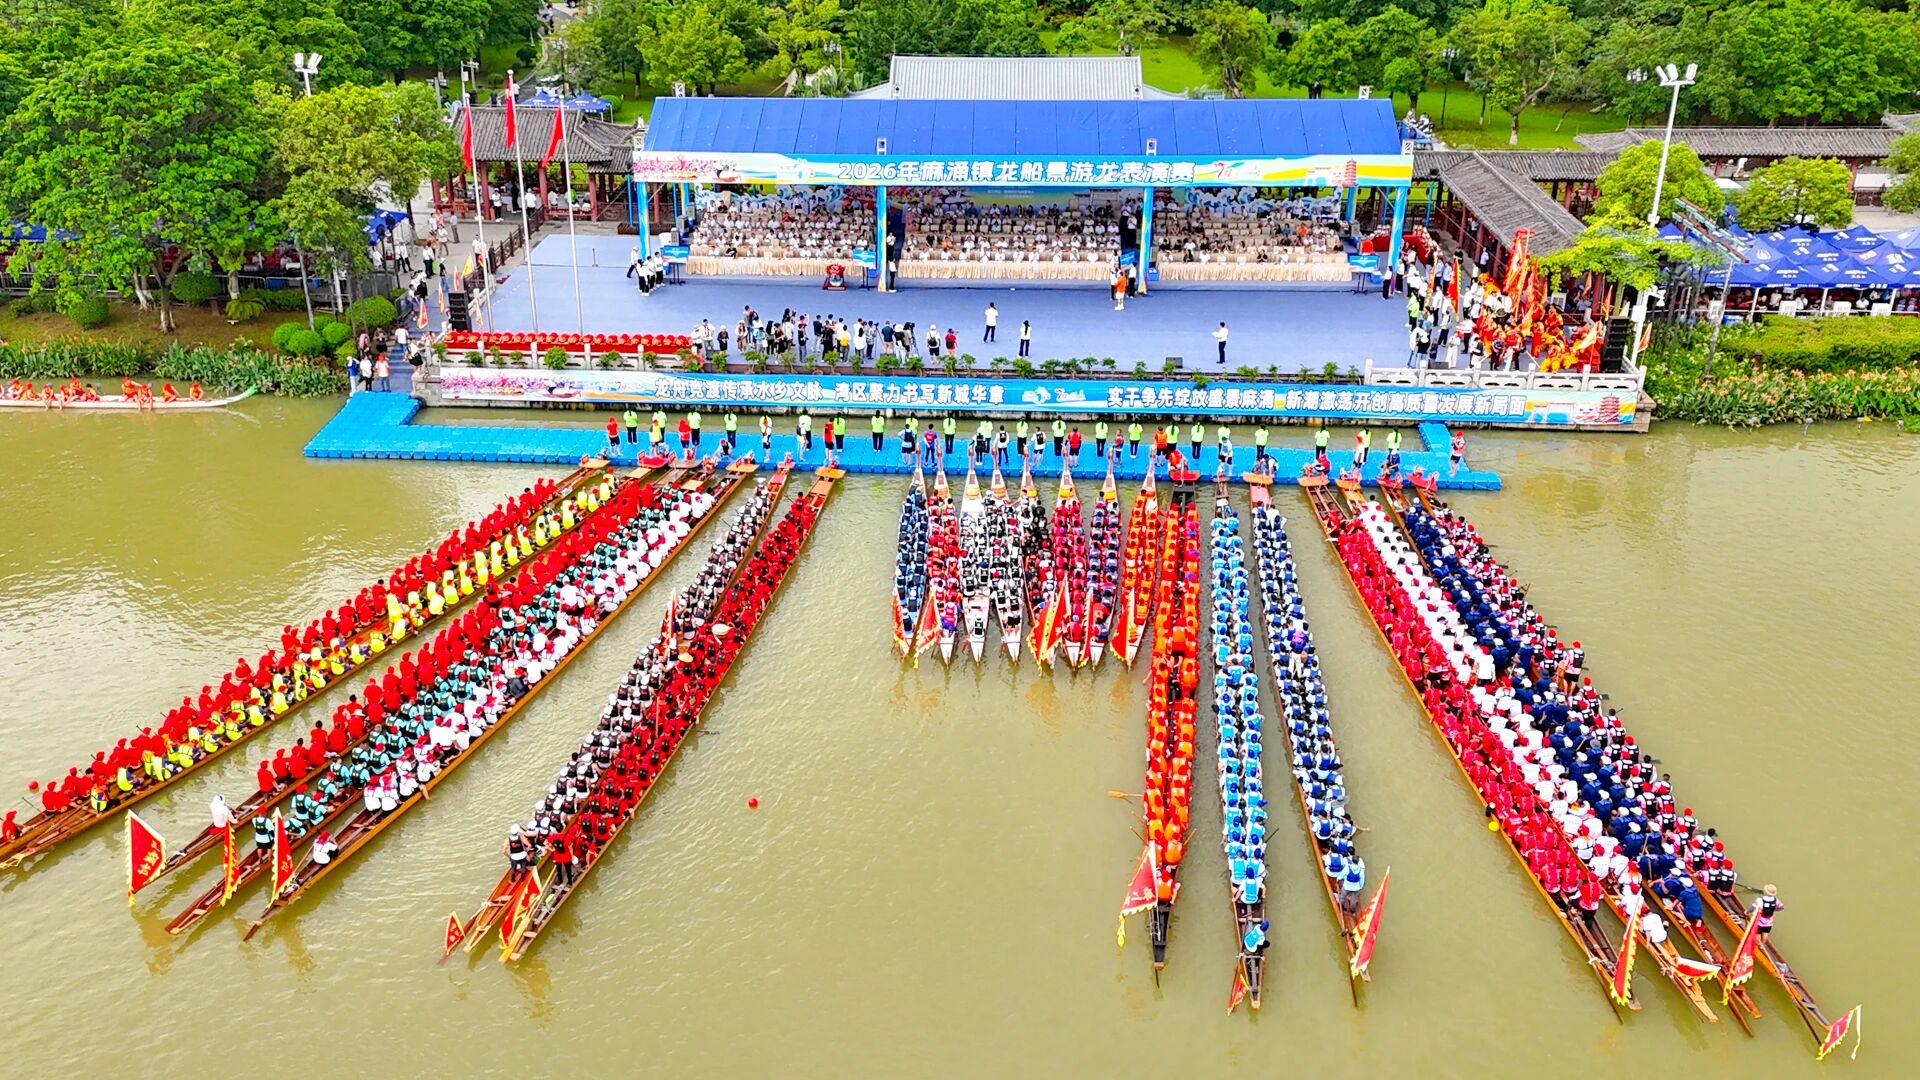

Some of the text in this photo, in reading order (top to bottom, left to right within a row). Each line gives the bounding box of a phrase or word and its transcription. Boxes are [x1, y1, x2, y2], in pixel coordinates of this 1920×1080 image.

[838, 161, 1196, 183] 2026年麻涌镇龙船景游龙表演赛
[655, 380, 823, 400] 龙舟竞渡传承水乡文脉
[835, 381, 1004, 404] 湾区聚力书写新城华章
[1107, 386, 1275, 410] 实干争先绽放盛景麻涌
[1286, 390, 1526, 416] 新潮激荡开创高质量发展新局面
